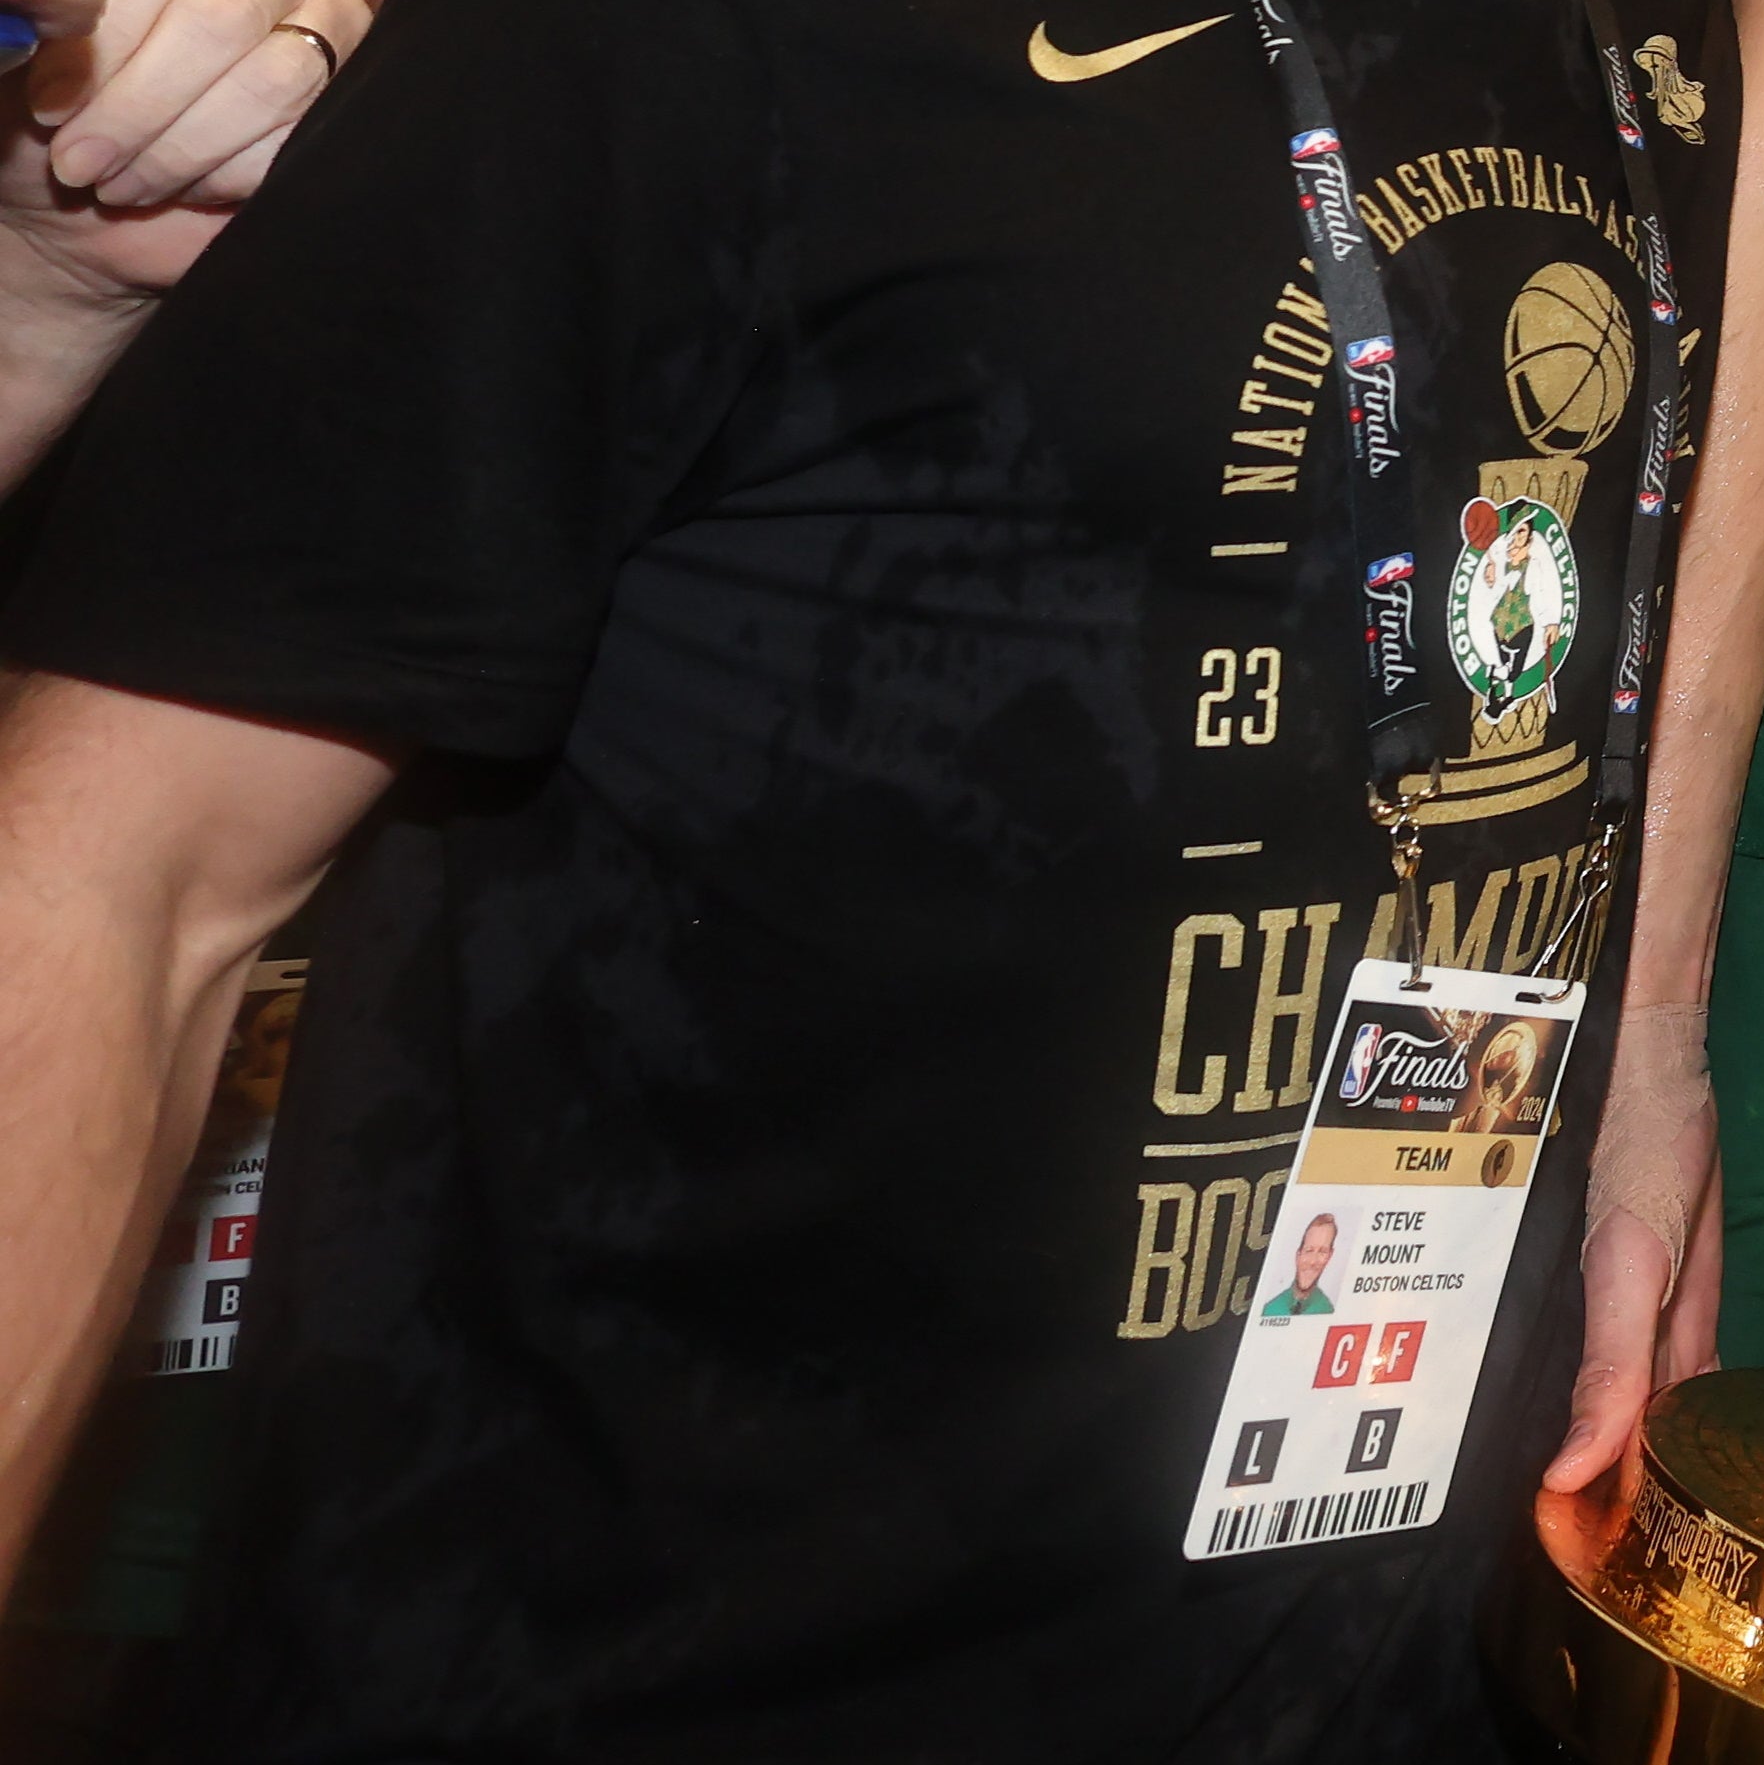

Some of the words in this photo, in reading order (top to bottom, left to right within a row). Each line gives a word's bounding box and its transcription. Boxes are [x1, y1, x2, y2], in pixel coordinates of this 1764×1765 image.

[1290, 152, 1363, 262] Finals
[1356, 146, 1601, 254] BASKETBALL
[1343, 362, 1402, 479] Finals
[1643, 394, 1673, 502] Finals
[1453, 549, 1481, 678] BOSTON
[1545, 522, 1576, 640] CELTICS
[1363, 580, 1418, 696] Finals
[1195, 646, 1282, 748] 23
[1346, 1031, 1470, 1108] Finals
[1516, 1095, 1547, 1123] 2024
[1394, 1146, 1453, 1172] TEAM
[227, 1222, 247, 1254] F
[1360, 1244, 1425, 1265] MOUNT
[1371, 1210, 1427, 1232] STEVE
[219, 1285, 240, 1317] B
[1352, 1275, 1410, 1294] BOSTON
[1411, 1273, 1465, 1292] CELTICS
[1331, 1332, 1355, 1380] C
[1387, 1330, 1411, 1374] F
[1244, 1429, 1264, 1477] L
[1361, 1419, 1386, 1464] B
[1645, 1493, 1758, 1602] TROPHY
